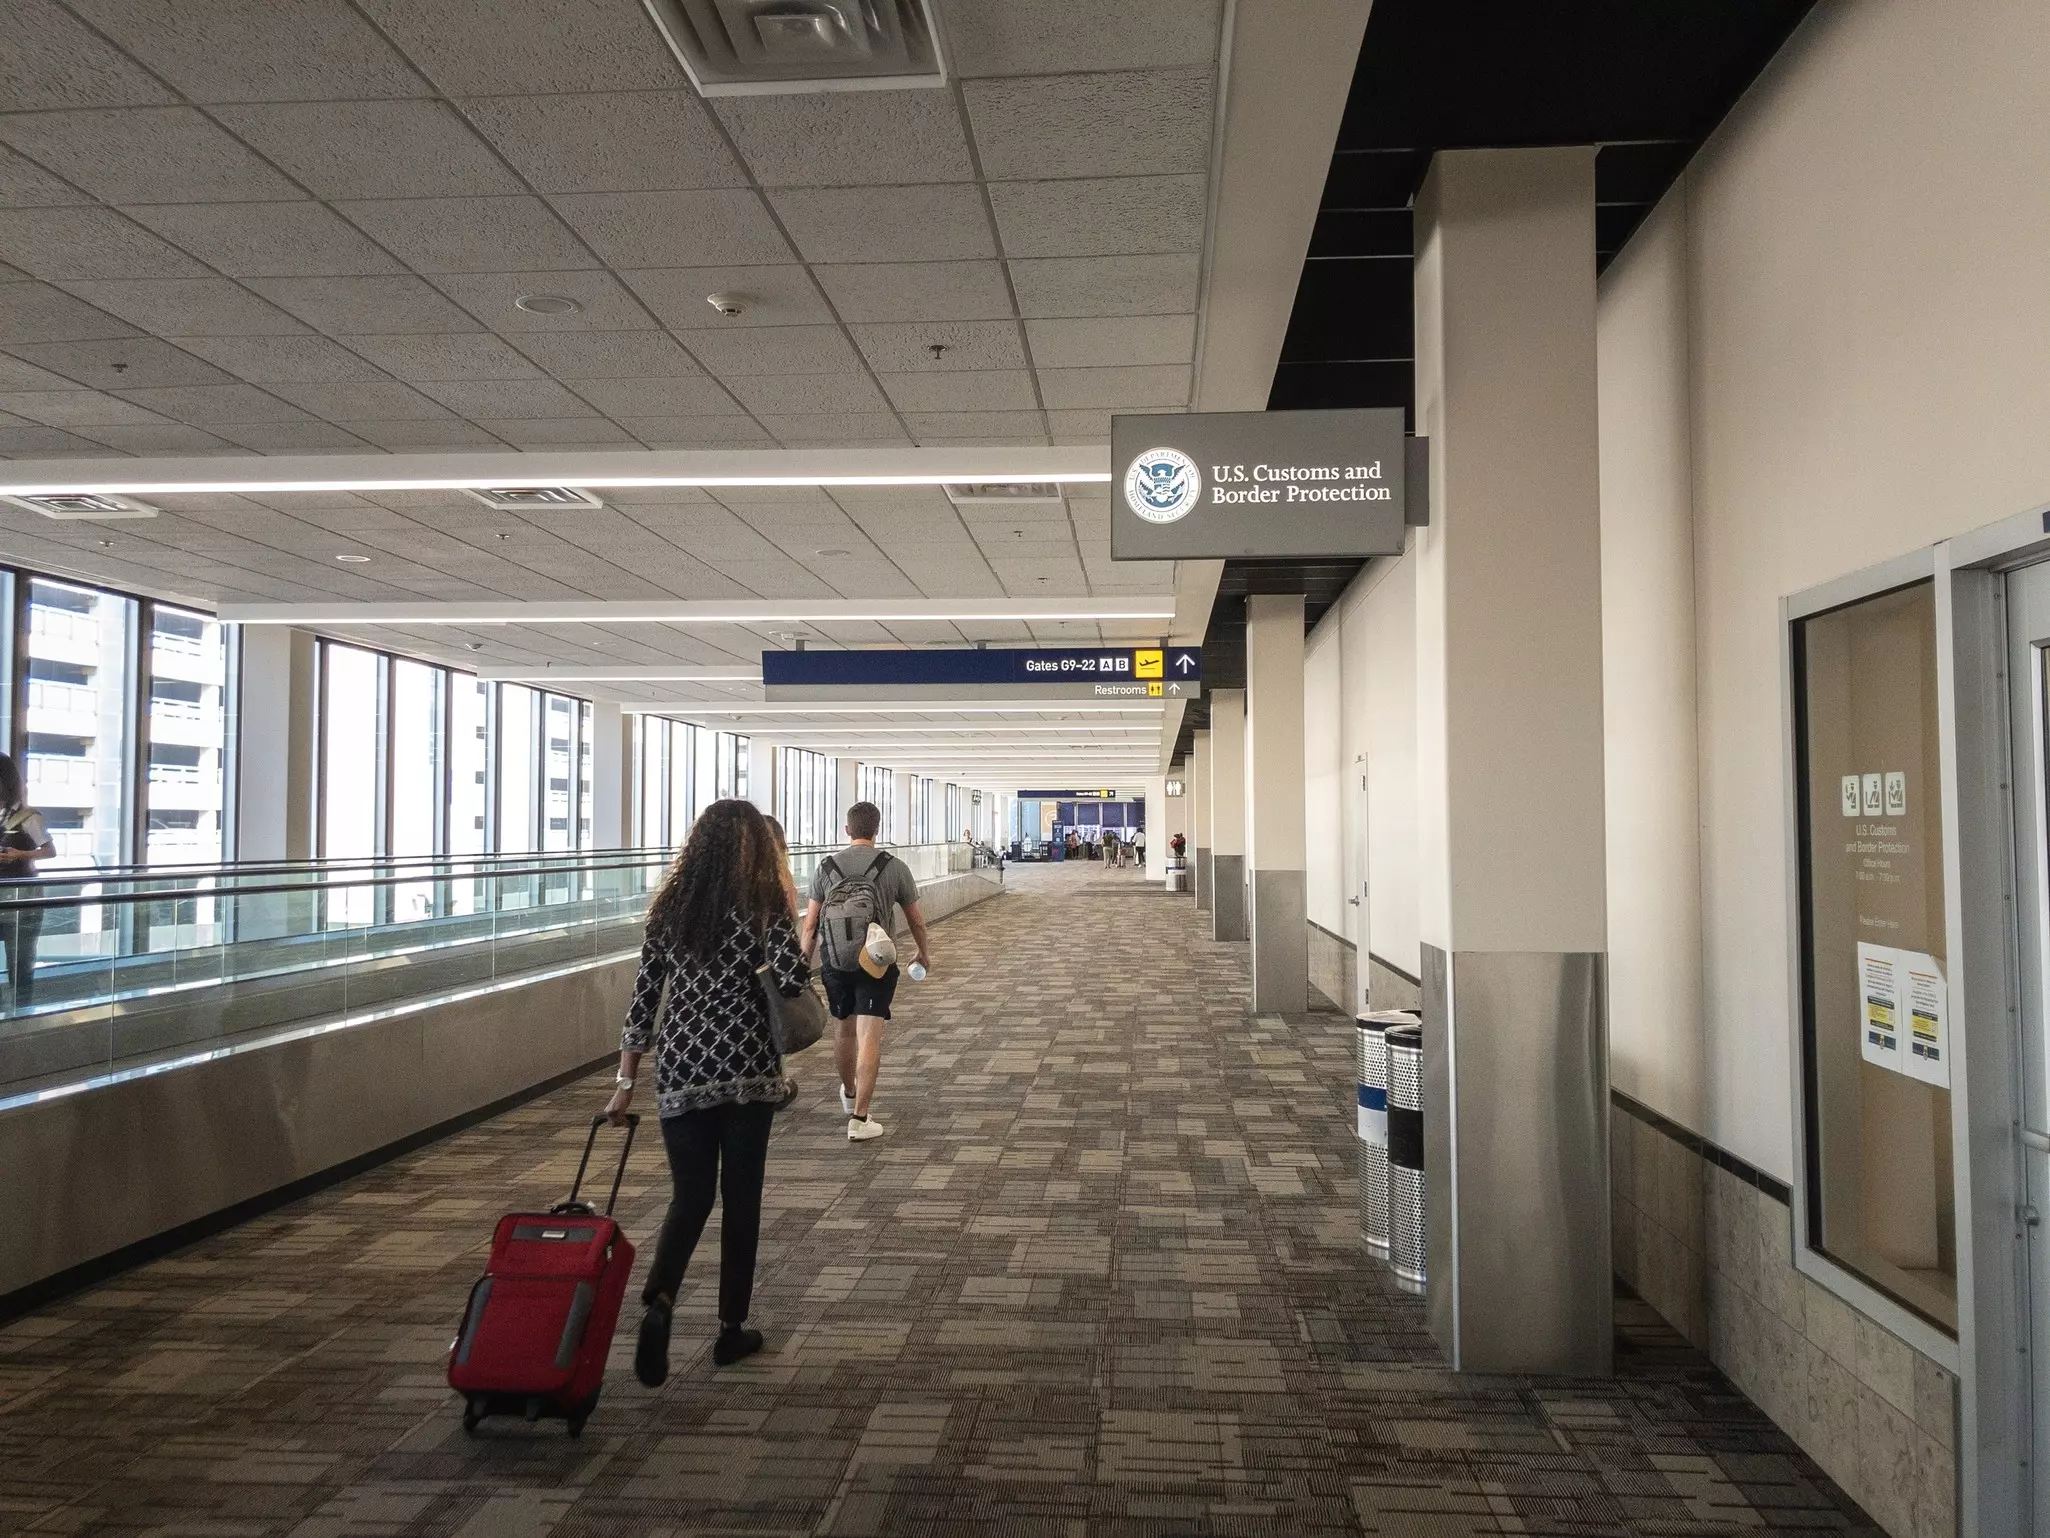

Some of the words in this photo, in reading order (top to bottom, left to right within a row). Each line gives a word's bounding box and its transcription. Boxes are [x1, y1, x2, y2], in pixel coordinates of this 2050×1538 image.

[1212, 465, 1249, 483] U.S.
[1253, 464, 1339, 481] Customs
[1344, 461, 1382, 480] and
[1212, 486, 1280, 504] Border
[1286, 484, 1392, 502] Protection
[1026, 660, 1059, 672] Gates
[1094, 685, 1147, 695] Restrooms
[1870, 824, 1897, 836] Customs
[1858, 841, 1877, 853] Border
[1878, 841, 1910, 854] Protection
